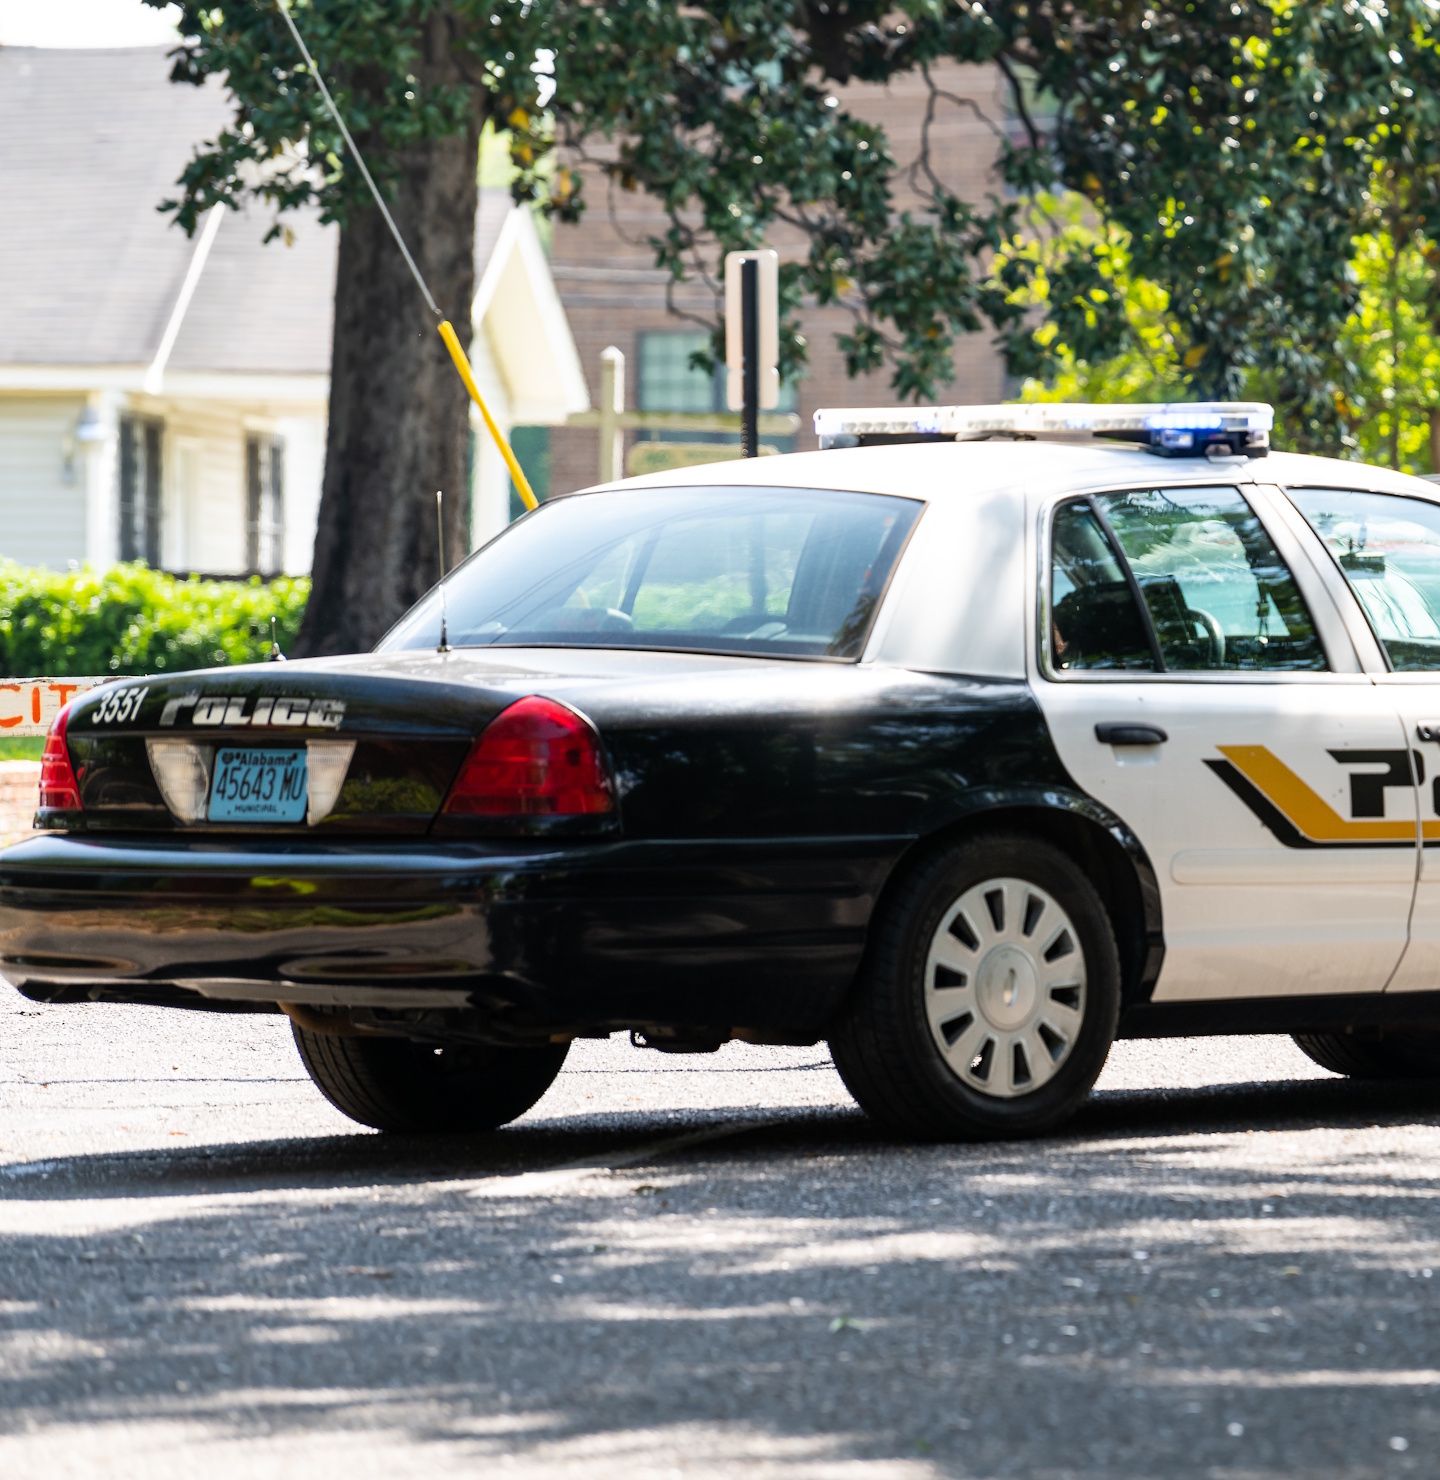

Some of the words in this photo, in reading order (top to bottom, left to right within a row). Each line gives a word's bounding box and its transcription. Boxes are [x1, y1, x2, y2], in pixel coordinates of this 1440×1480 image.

[0, 683, 92, 728] CIT
[92, 687, 149, 724] 3551
[159, 692, 346, 727] POLICE
[239, 752, 292, 767] Alabama
[216, 767, 276, 801] 45643
[279, 767, 307, 801] MU
[234, 804, 278, 814] MUNICIPAL
